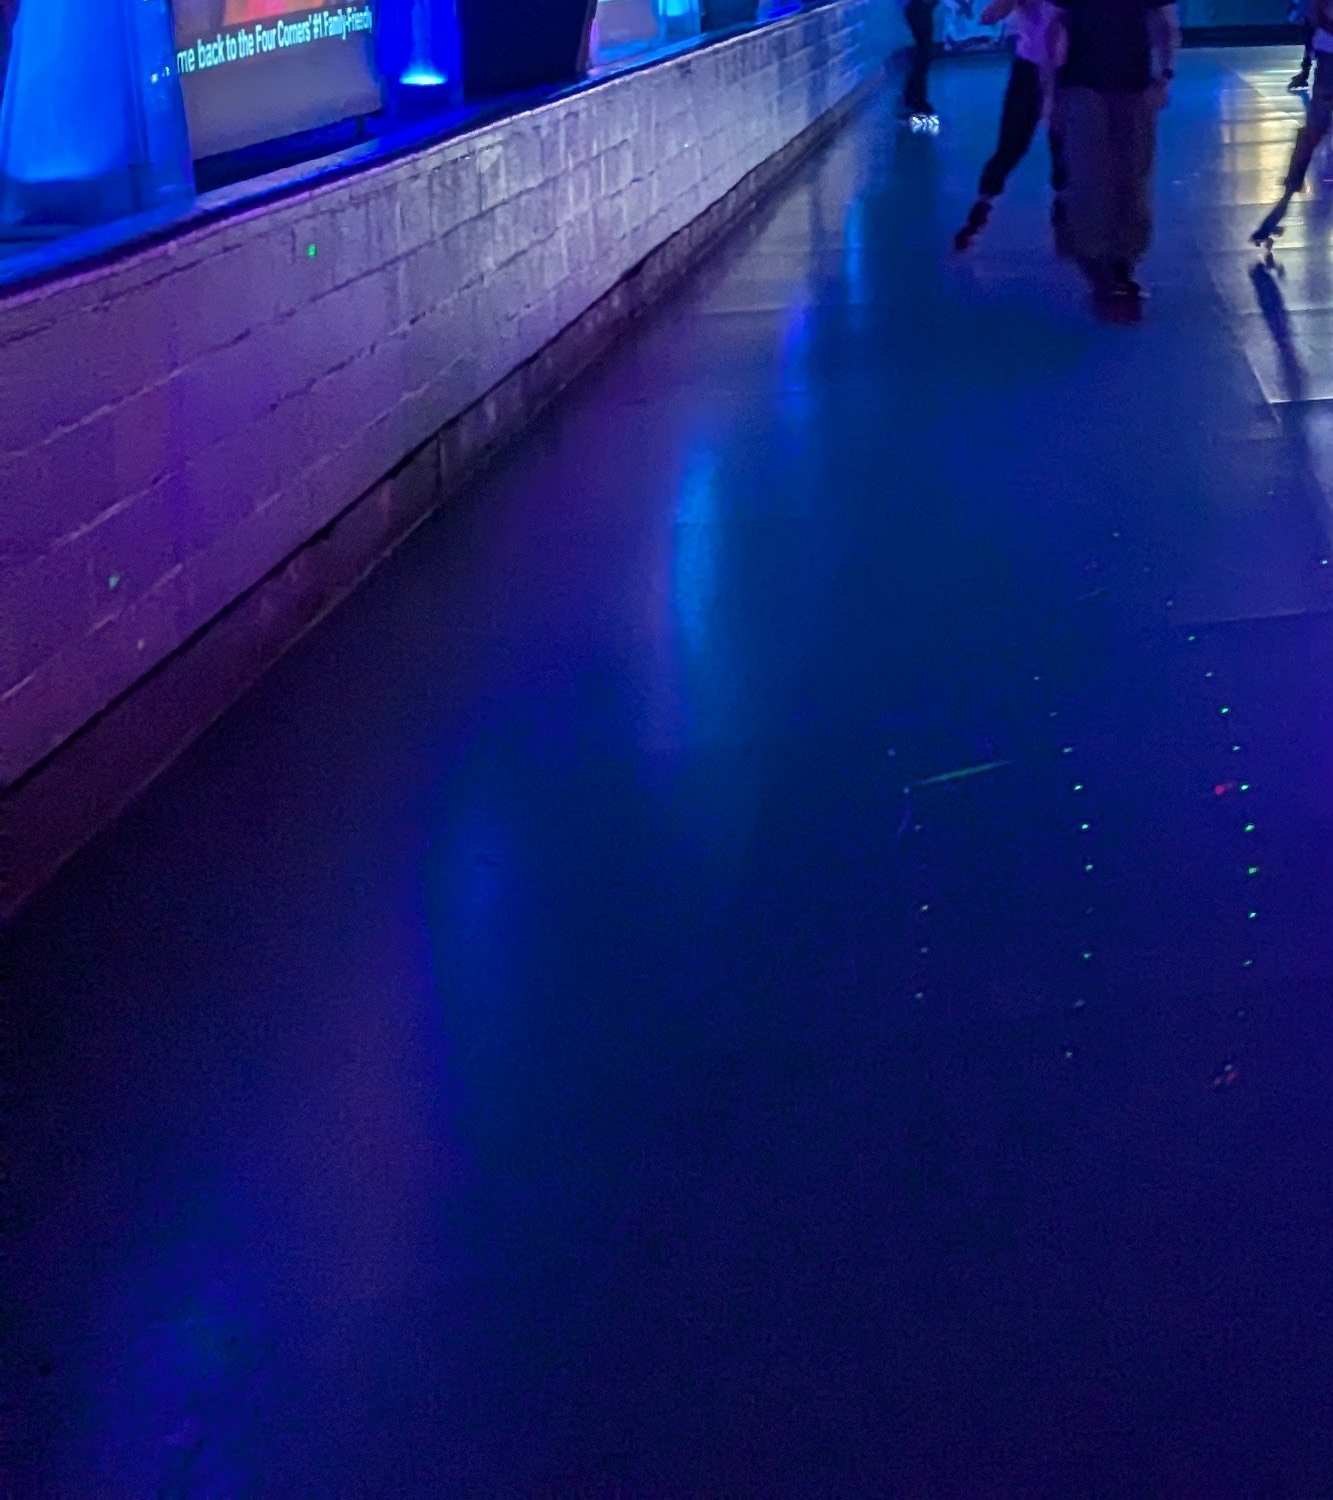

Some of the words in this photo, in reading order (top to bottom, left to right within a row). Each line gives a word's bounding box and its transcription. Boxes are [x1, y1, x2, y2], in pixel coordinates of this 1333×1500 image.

[197, 33, 225, 69] back
[226, 34, 237, 63] to
[237, 28, 254, 59] the
[255, 23, 277, 55] Four
